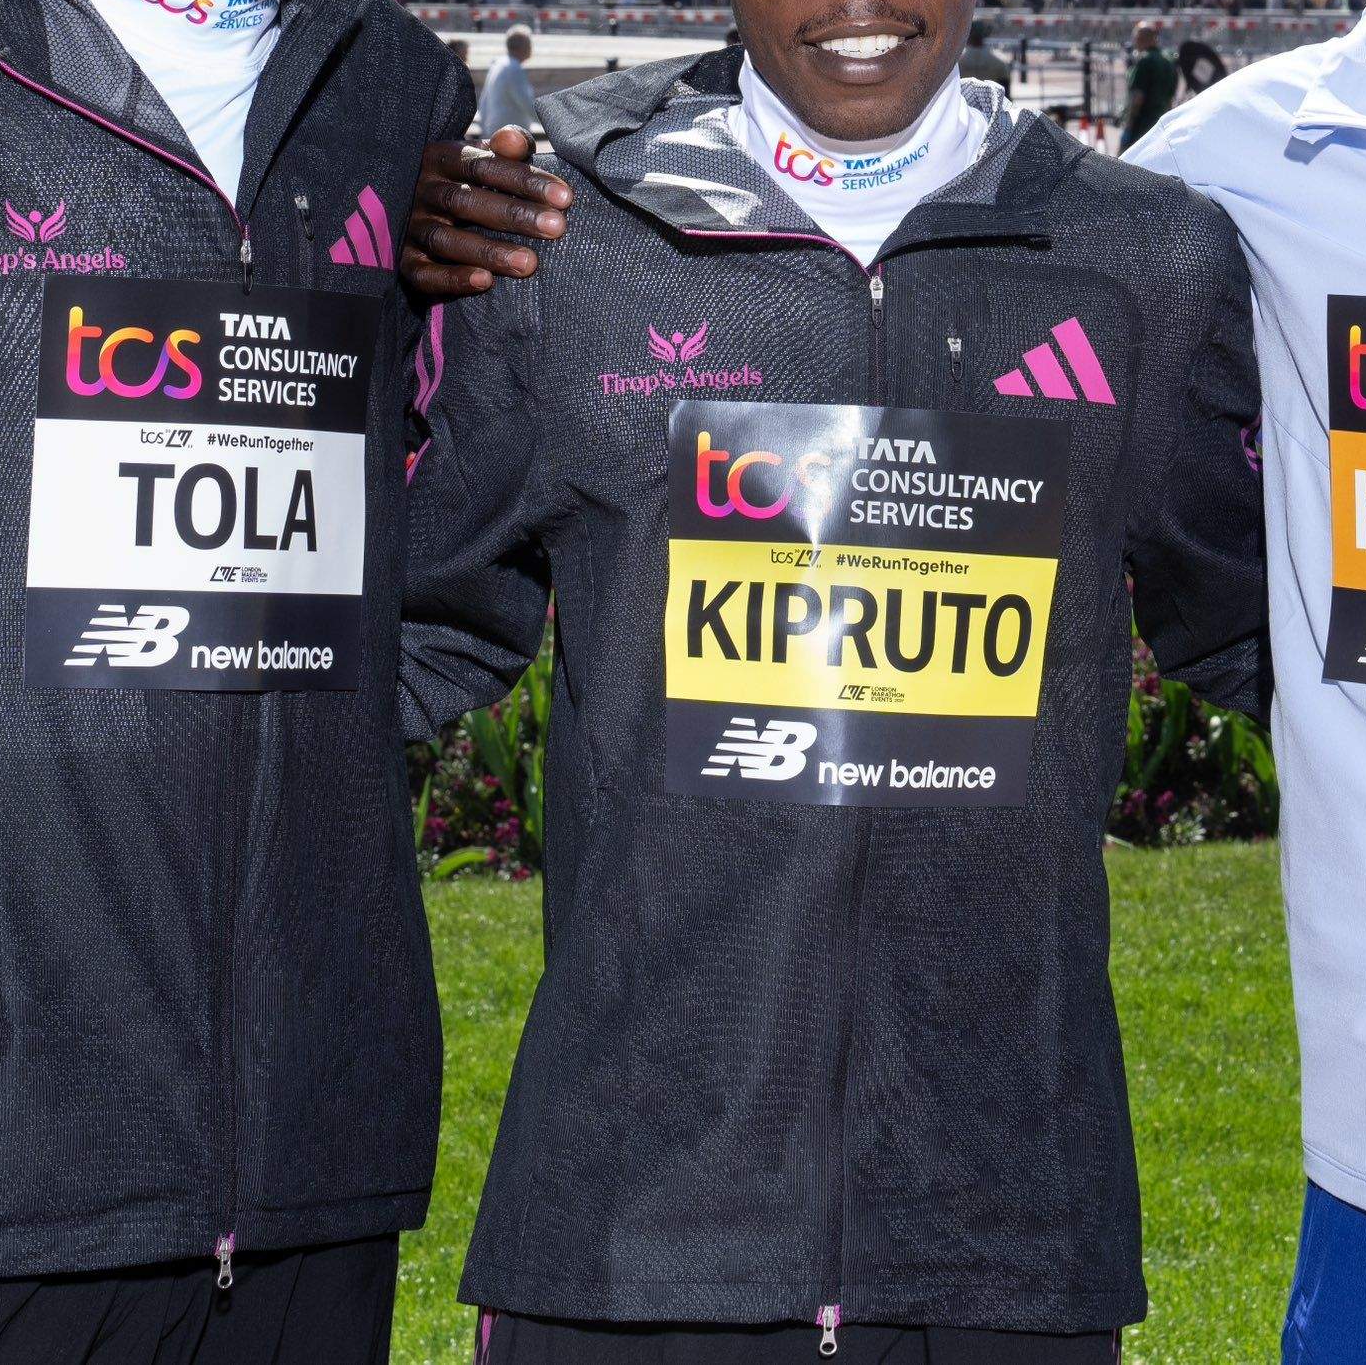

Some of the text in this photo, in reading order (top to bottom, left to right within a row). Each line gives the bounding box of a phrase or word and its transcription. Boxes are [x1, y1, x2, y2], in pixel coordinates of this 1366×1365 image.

[212, 14, 263, 29] SERVICES
[774, 132, 834, 187] tcs
[842, 170, 902, 190] SERVICES
[42, 246, 126, 273] Angels
[219, 313, 291, 341] TATA
[66, 306, 203, 399] tcs
[219, 345, 358, 378] CONSULTANCY
[218, 378, 317, 406] SERVICES
[598, 363, 763, 397] Tirop's Angels
[140, 428, 164, 444] tcs
[207, 433, 314, 453] #WeRunTogether
[854, 437, 936, 464] TATA
[696, 431, 831, 519] tcs
[851, 468, 1044, 504] CONSULTANCY
[119, 462, 317, 552] TOLA
[850, 500, 974, 530] SERVICES
[771, 549, 794, 564] tcs
[836, 553, 969, 575] #WeRunTogether
[63, 604, 333, 670] NB new balance
[687, 579, 1033, 678] KIPRUTO
[701, 717, 996, 789] NB new balance
